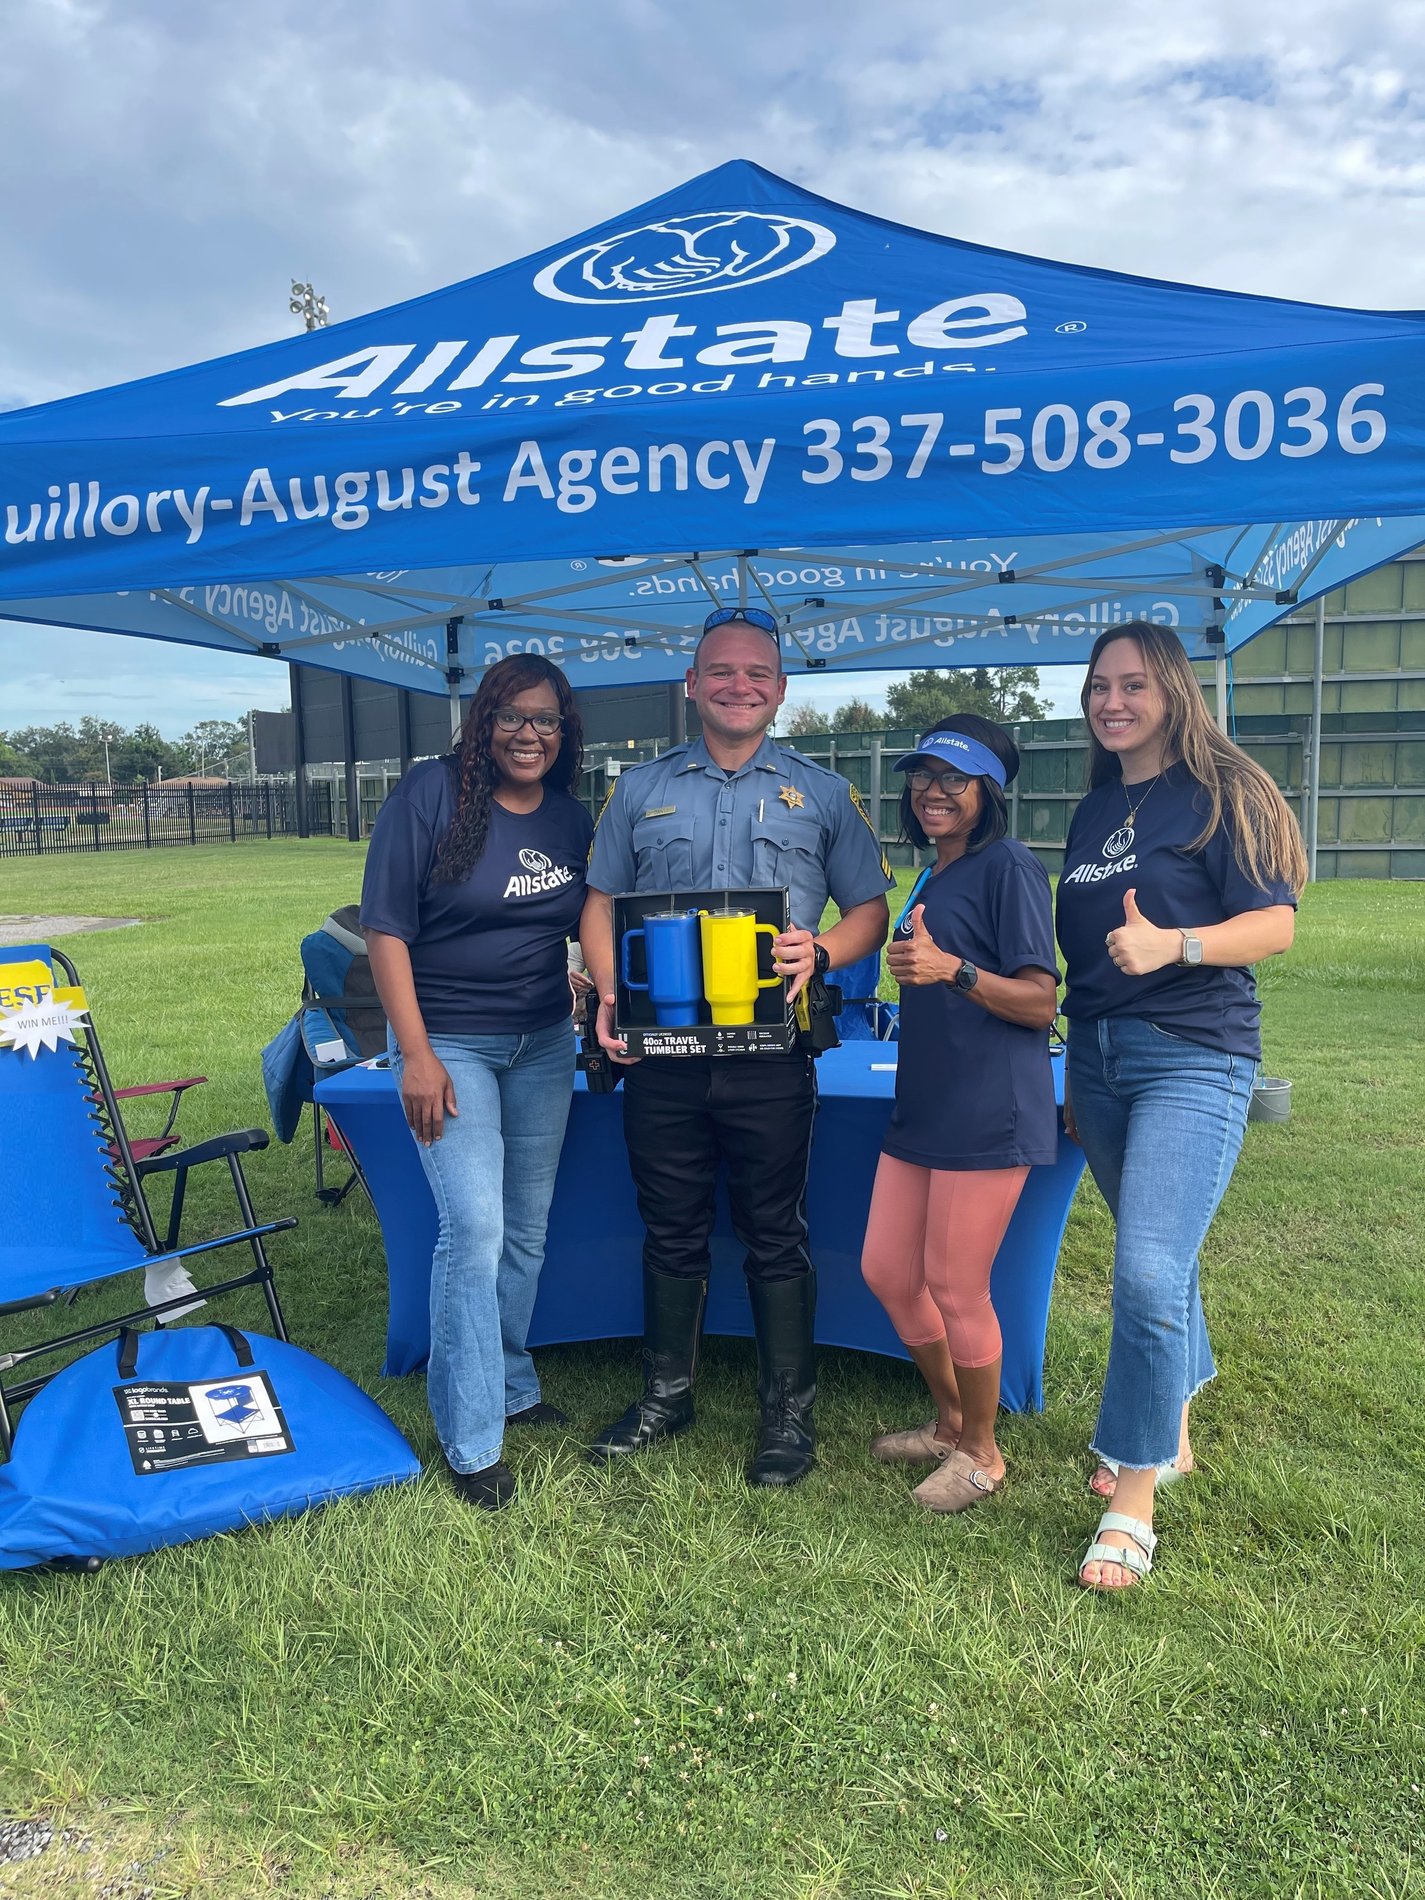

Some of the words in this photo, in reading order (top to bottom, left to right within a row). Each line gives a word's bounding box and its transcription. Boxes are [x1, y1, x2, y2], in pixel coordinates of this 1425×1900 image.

[215, 292, 1029, 407] Allstate
[269, 400, 463, 424] You're
[481, 393, 540, 411] in
[554, 373, 737, 408] good
[757, 360, 997, 389] hands.
[4, 451, 482, 546] uillory-August
[502, 438, 777, 506] Agency
[801, 382, 1388, 486] 337-508-3036
[17, 1018, 39, 1030] WIN
[642, 1036, 664, 1046] 40oz
[663, 1036, 700, 1045] TRAVEL
[644, 1046, 688, 1055] TUMBLER
[689, 1045, 707, 1054] SET
[139, 1397, 167, 1405] ROUND
[166, 1397, 192, 1405] TABLE
